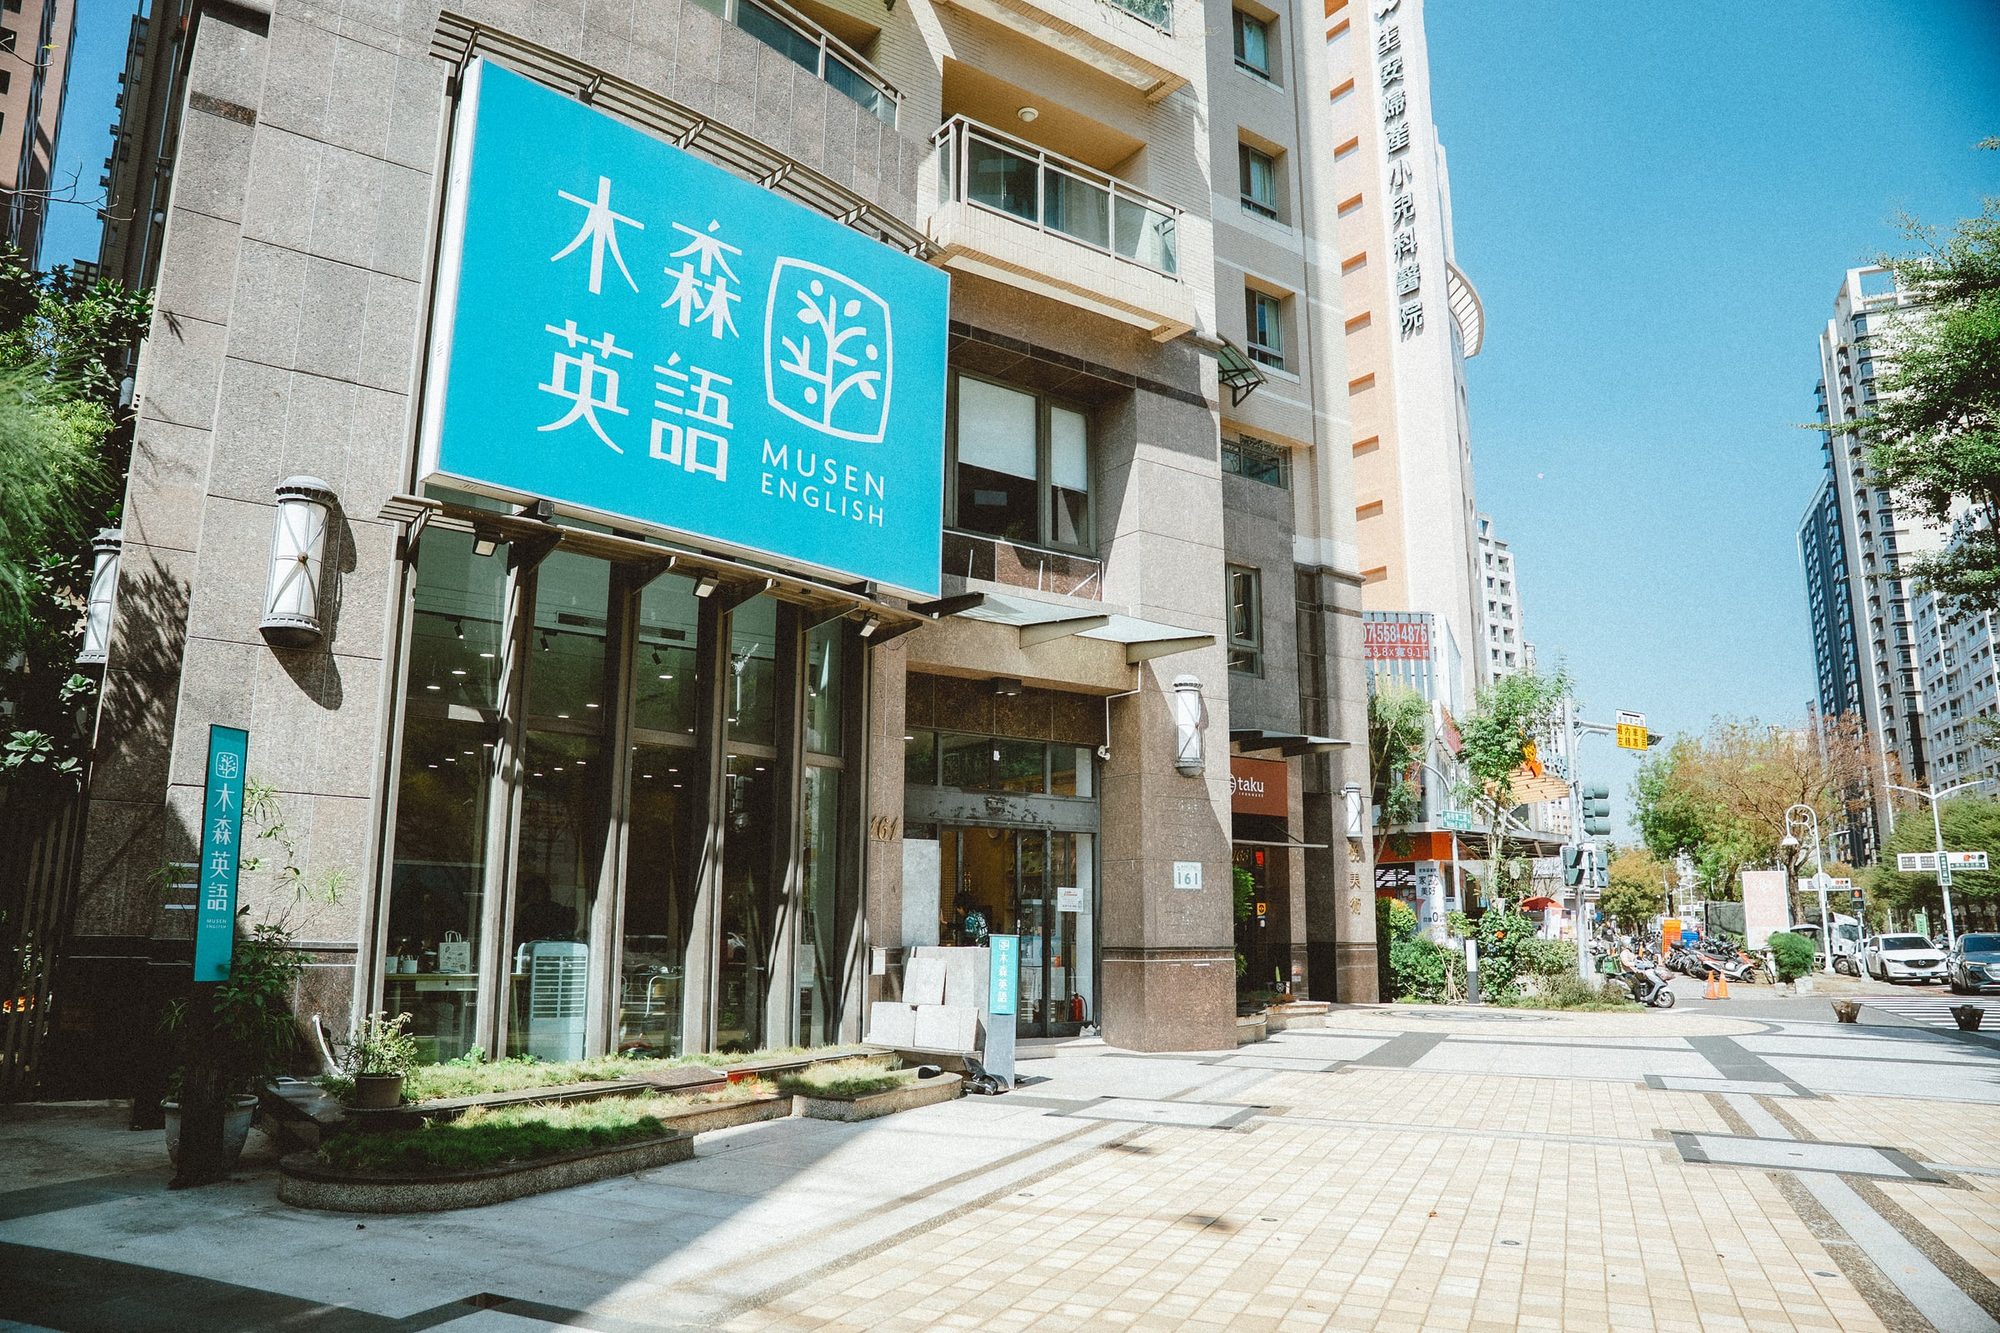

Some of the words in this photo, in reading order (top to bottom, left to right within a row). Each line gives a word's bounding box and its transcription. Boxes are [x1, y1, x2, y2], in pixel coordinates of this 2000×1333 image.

[550, 175, 743, 340] 木森
[537, 318, 734, 482] 英語
[761, 438, 885, 501] MUSEN
[761, 472, 884, 527] ENGLISH
[1237, 776, 1264, 793] taku
[207, 783, 235, 912] 木森英語
[870, 815, 899, 841] 161
[1177, 871, 1198, 885] 161
[997, 951, 1008, 1003] 木森英語
